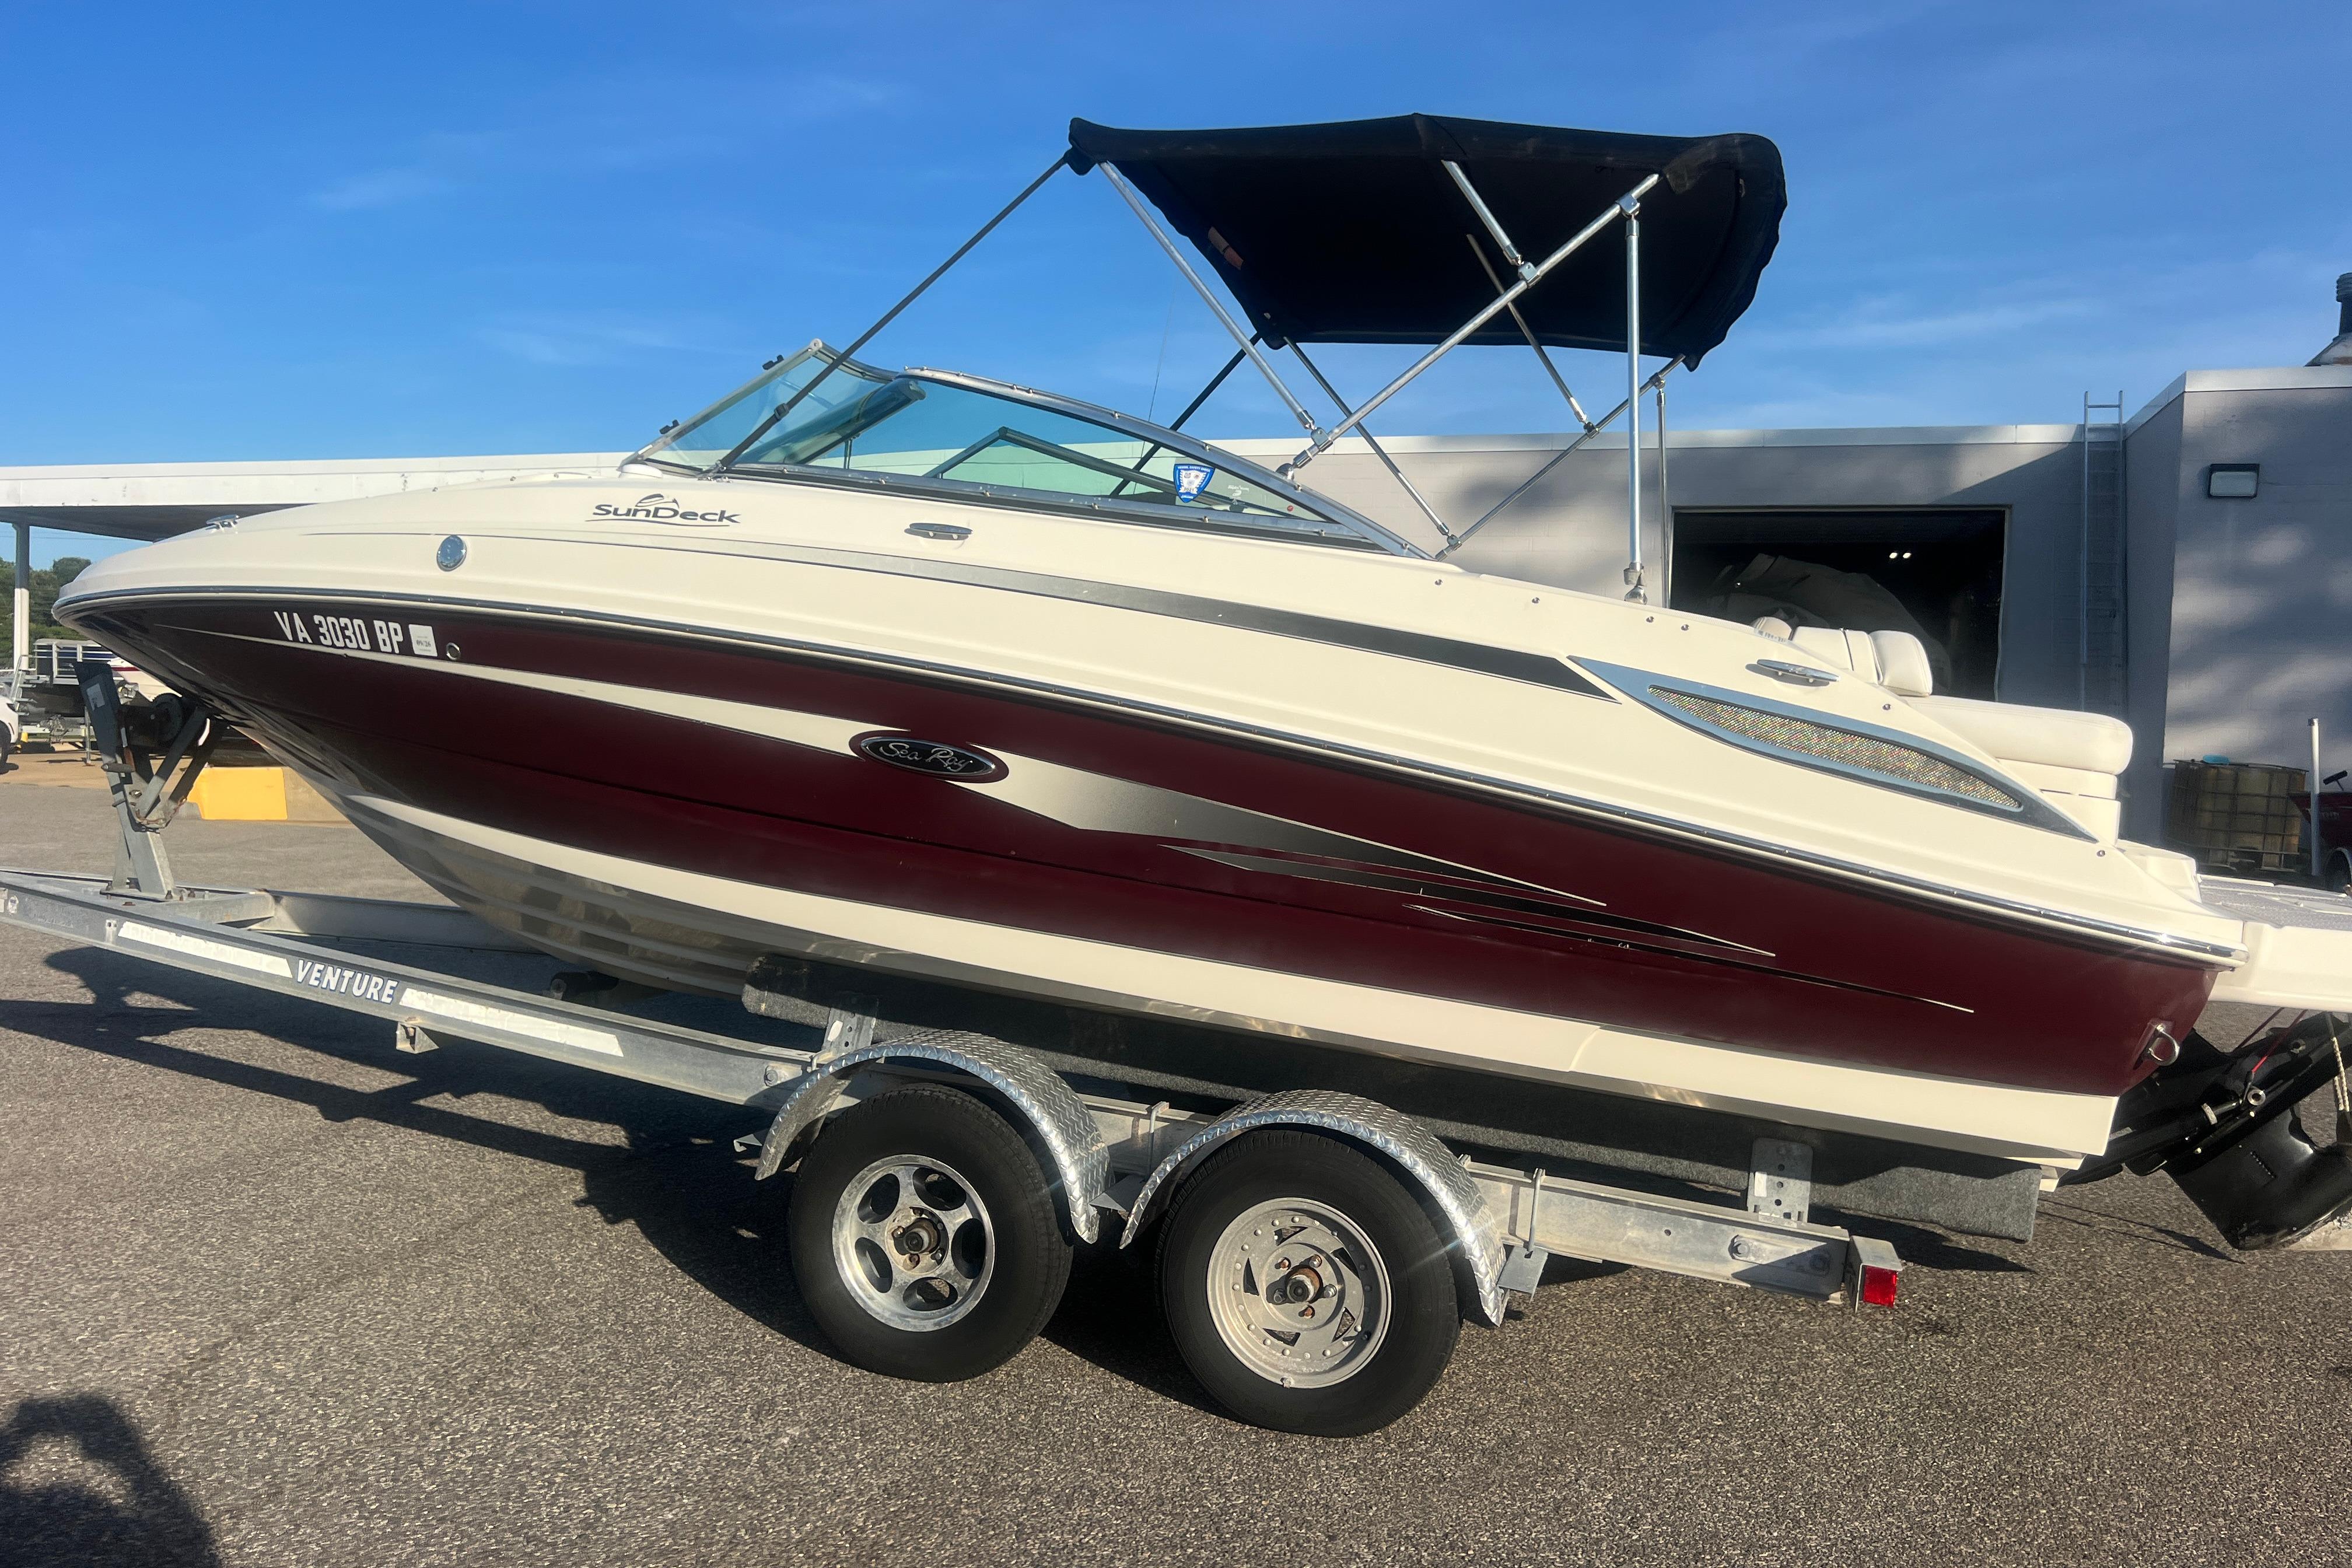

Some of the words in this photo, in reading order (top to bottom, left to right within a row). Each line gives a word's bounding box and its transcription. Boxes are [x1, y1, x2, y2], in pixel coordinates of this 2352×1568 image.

[593, 504, 741, 523] SunDeck
[274, 611, 313, 643] VA
[313, 614, 371, 650] 3030
[373, 620, 404, 654] BP
[879, 743, 922, 761] Sea
[926, 748, 970, 772] Ray
[297, 959, 399, 1005] VENTURE
